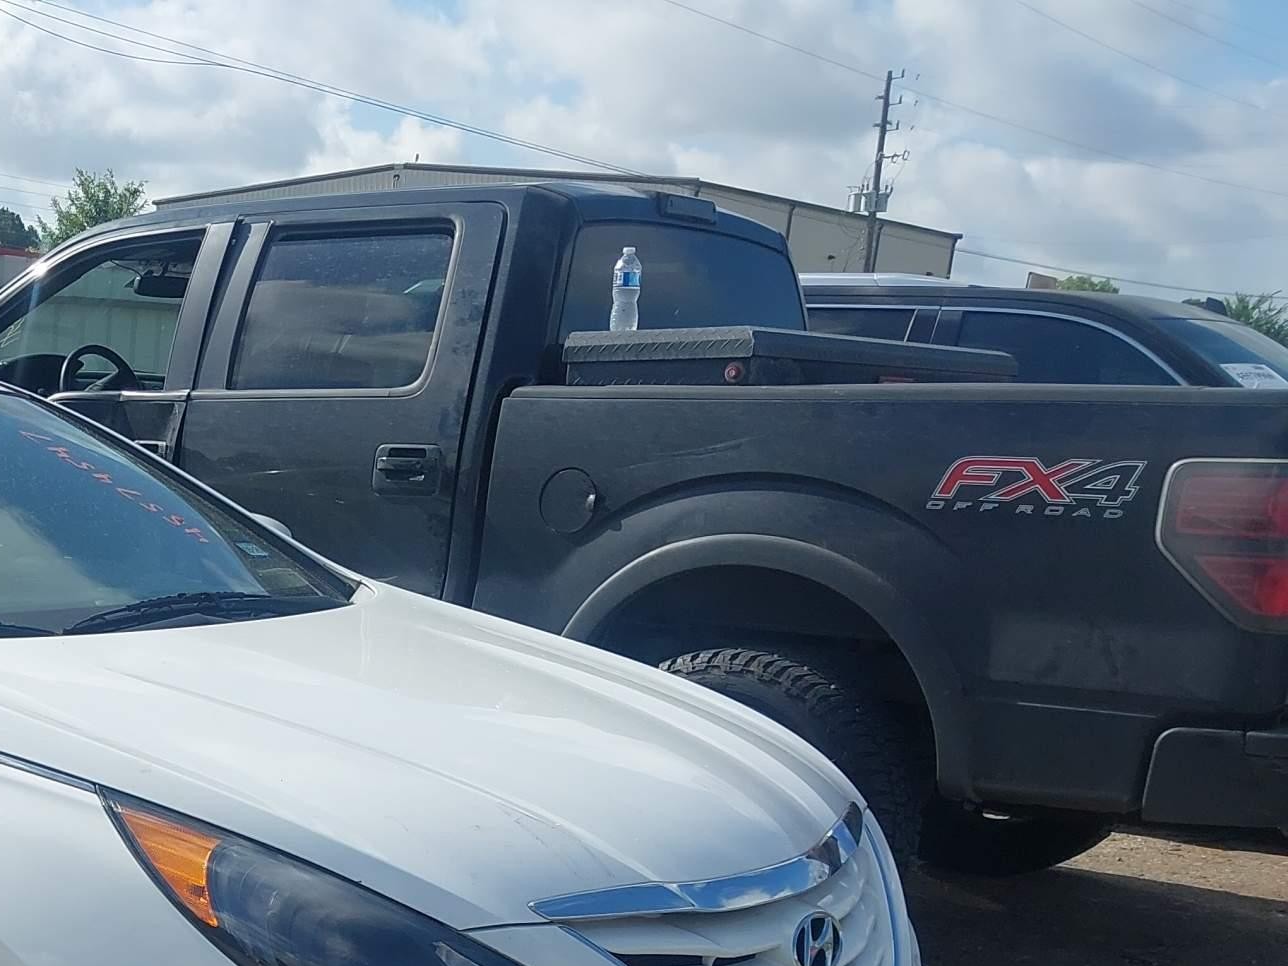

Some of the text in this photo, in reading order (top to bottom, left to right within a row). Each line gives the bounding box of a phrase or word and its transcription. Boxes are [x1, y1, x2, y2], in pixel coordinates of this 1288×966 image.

[930, 455, 1148, 507] FX4
[925, 500, 1125, 519] OFF ROAD
